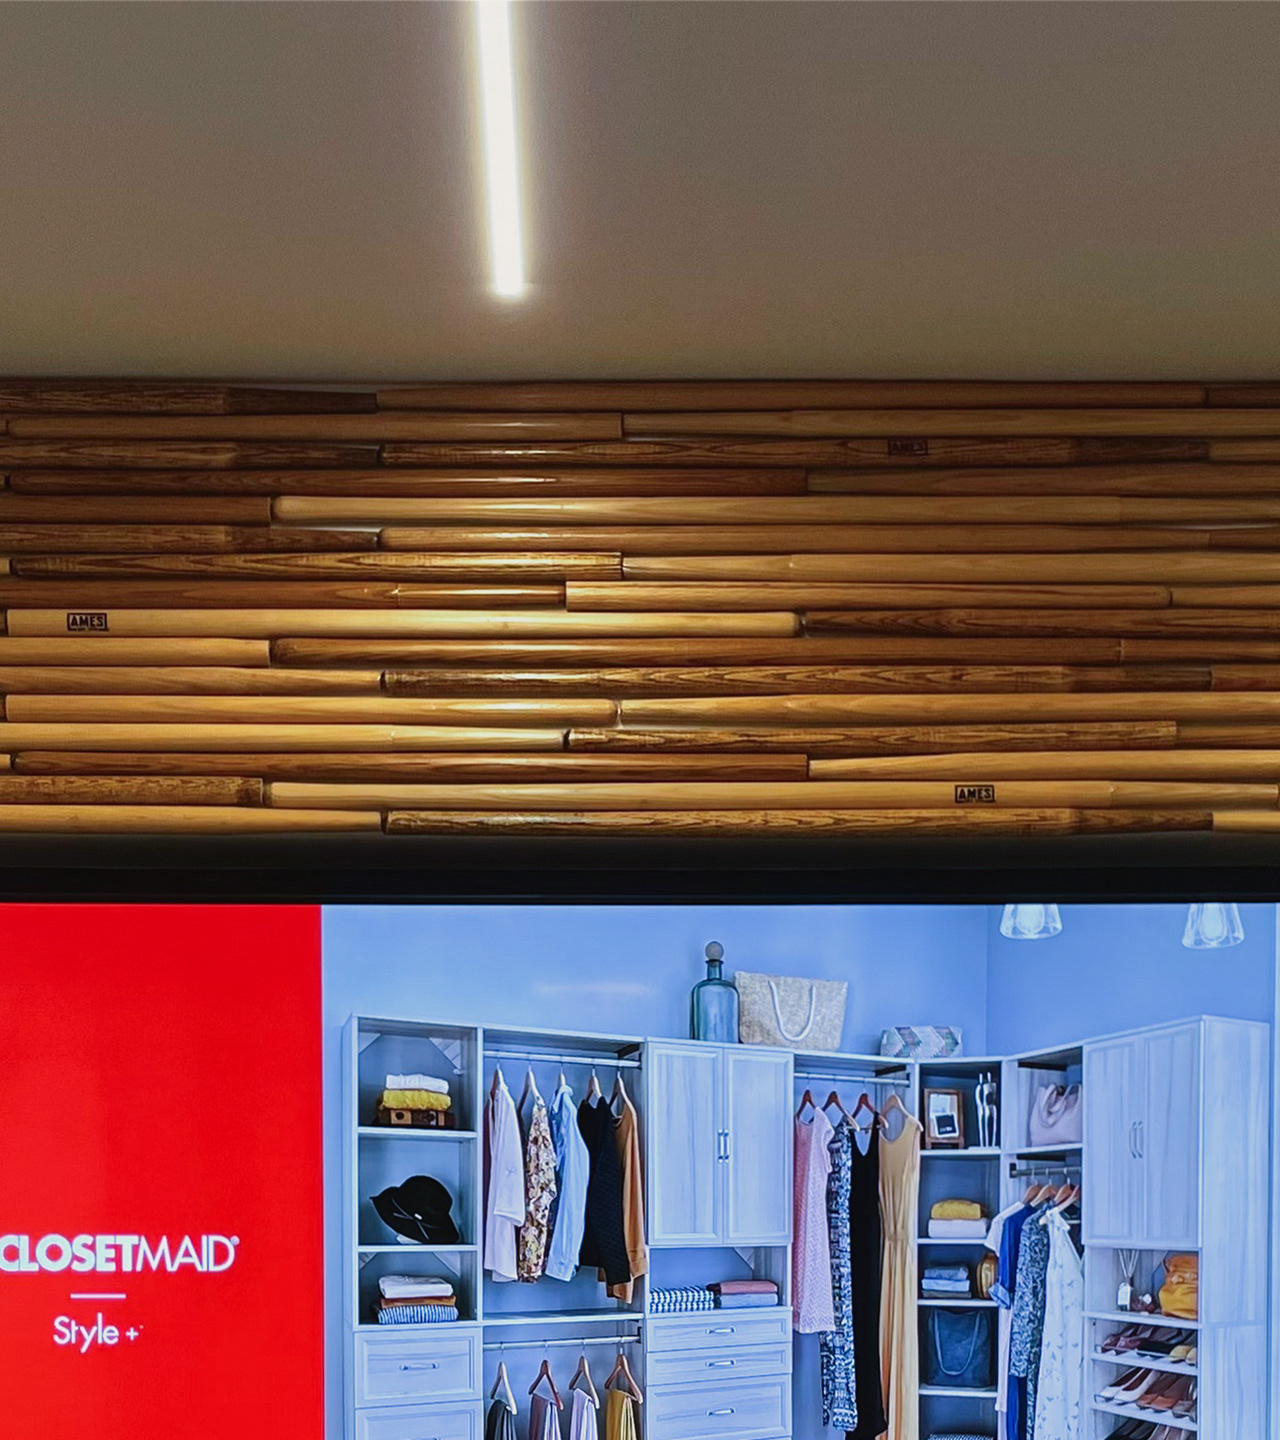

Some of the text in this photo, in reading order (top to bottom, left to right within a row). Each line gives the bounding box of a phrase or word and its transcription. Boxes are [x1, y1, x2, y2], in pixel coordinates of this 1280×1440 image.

[69, 614, 105, 628] AMES
[957, 787, 993, 799] AMES
[53, 1312, 119, 1354] Style
